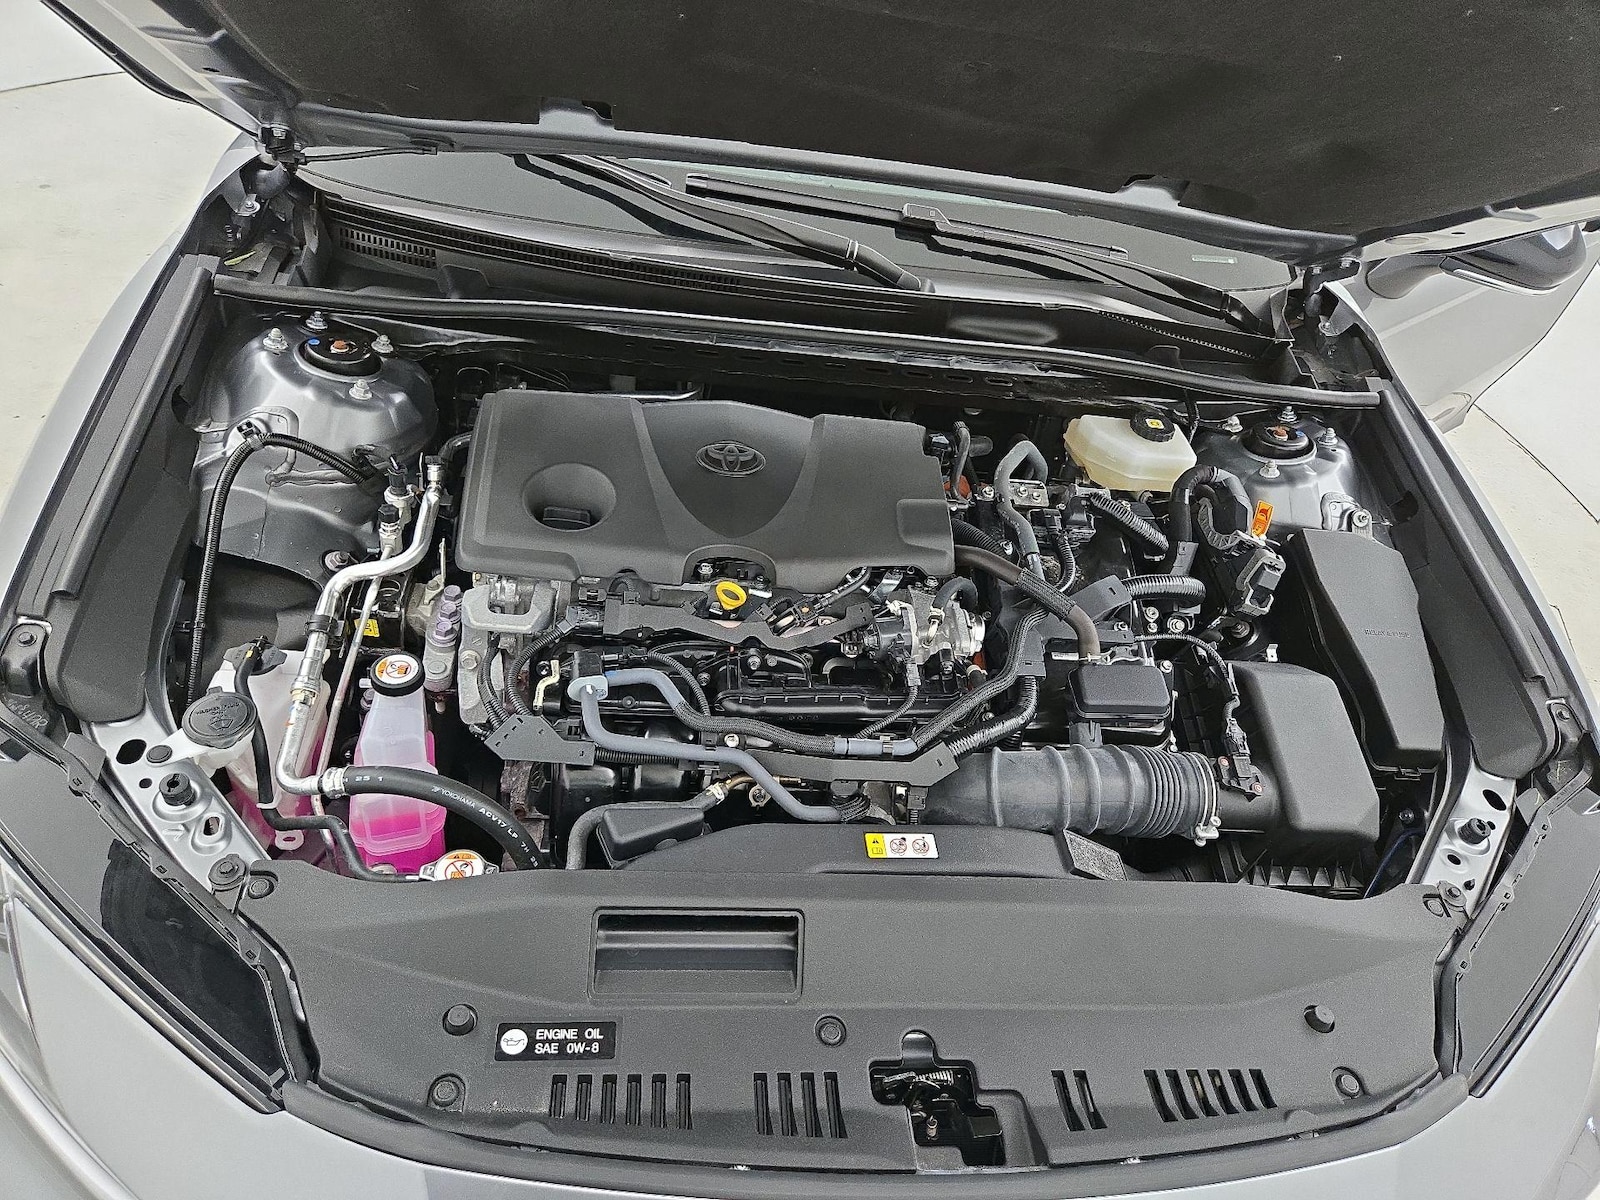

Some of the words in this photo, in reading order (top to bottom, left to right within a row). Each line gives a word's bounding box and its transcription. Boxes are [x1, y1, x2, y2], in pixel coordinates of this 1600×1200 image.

[440, 787, 476, 809] YOKOHAMA
[479, 807, 507, 828] ACV17
[507, 828, 519, 839] LP
[535, 1028, 578, 1040] ENGINE
[584, 1027, 604, 1040] OIL
[534, 1042, 559, 1055] SAE
[566, 1041, 600, 1054] 0W-8
